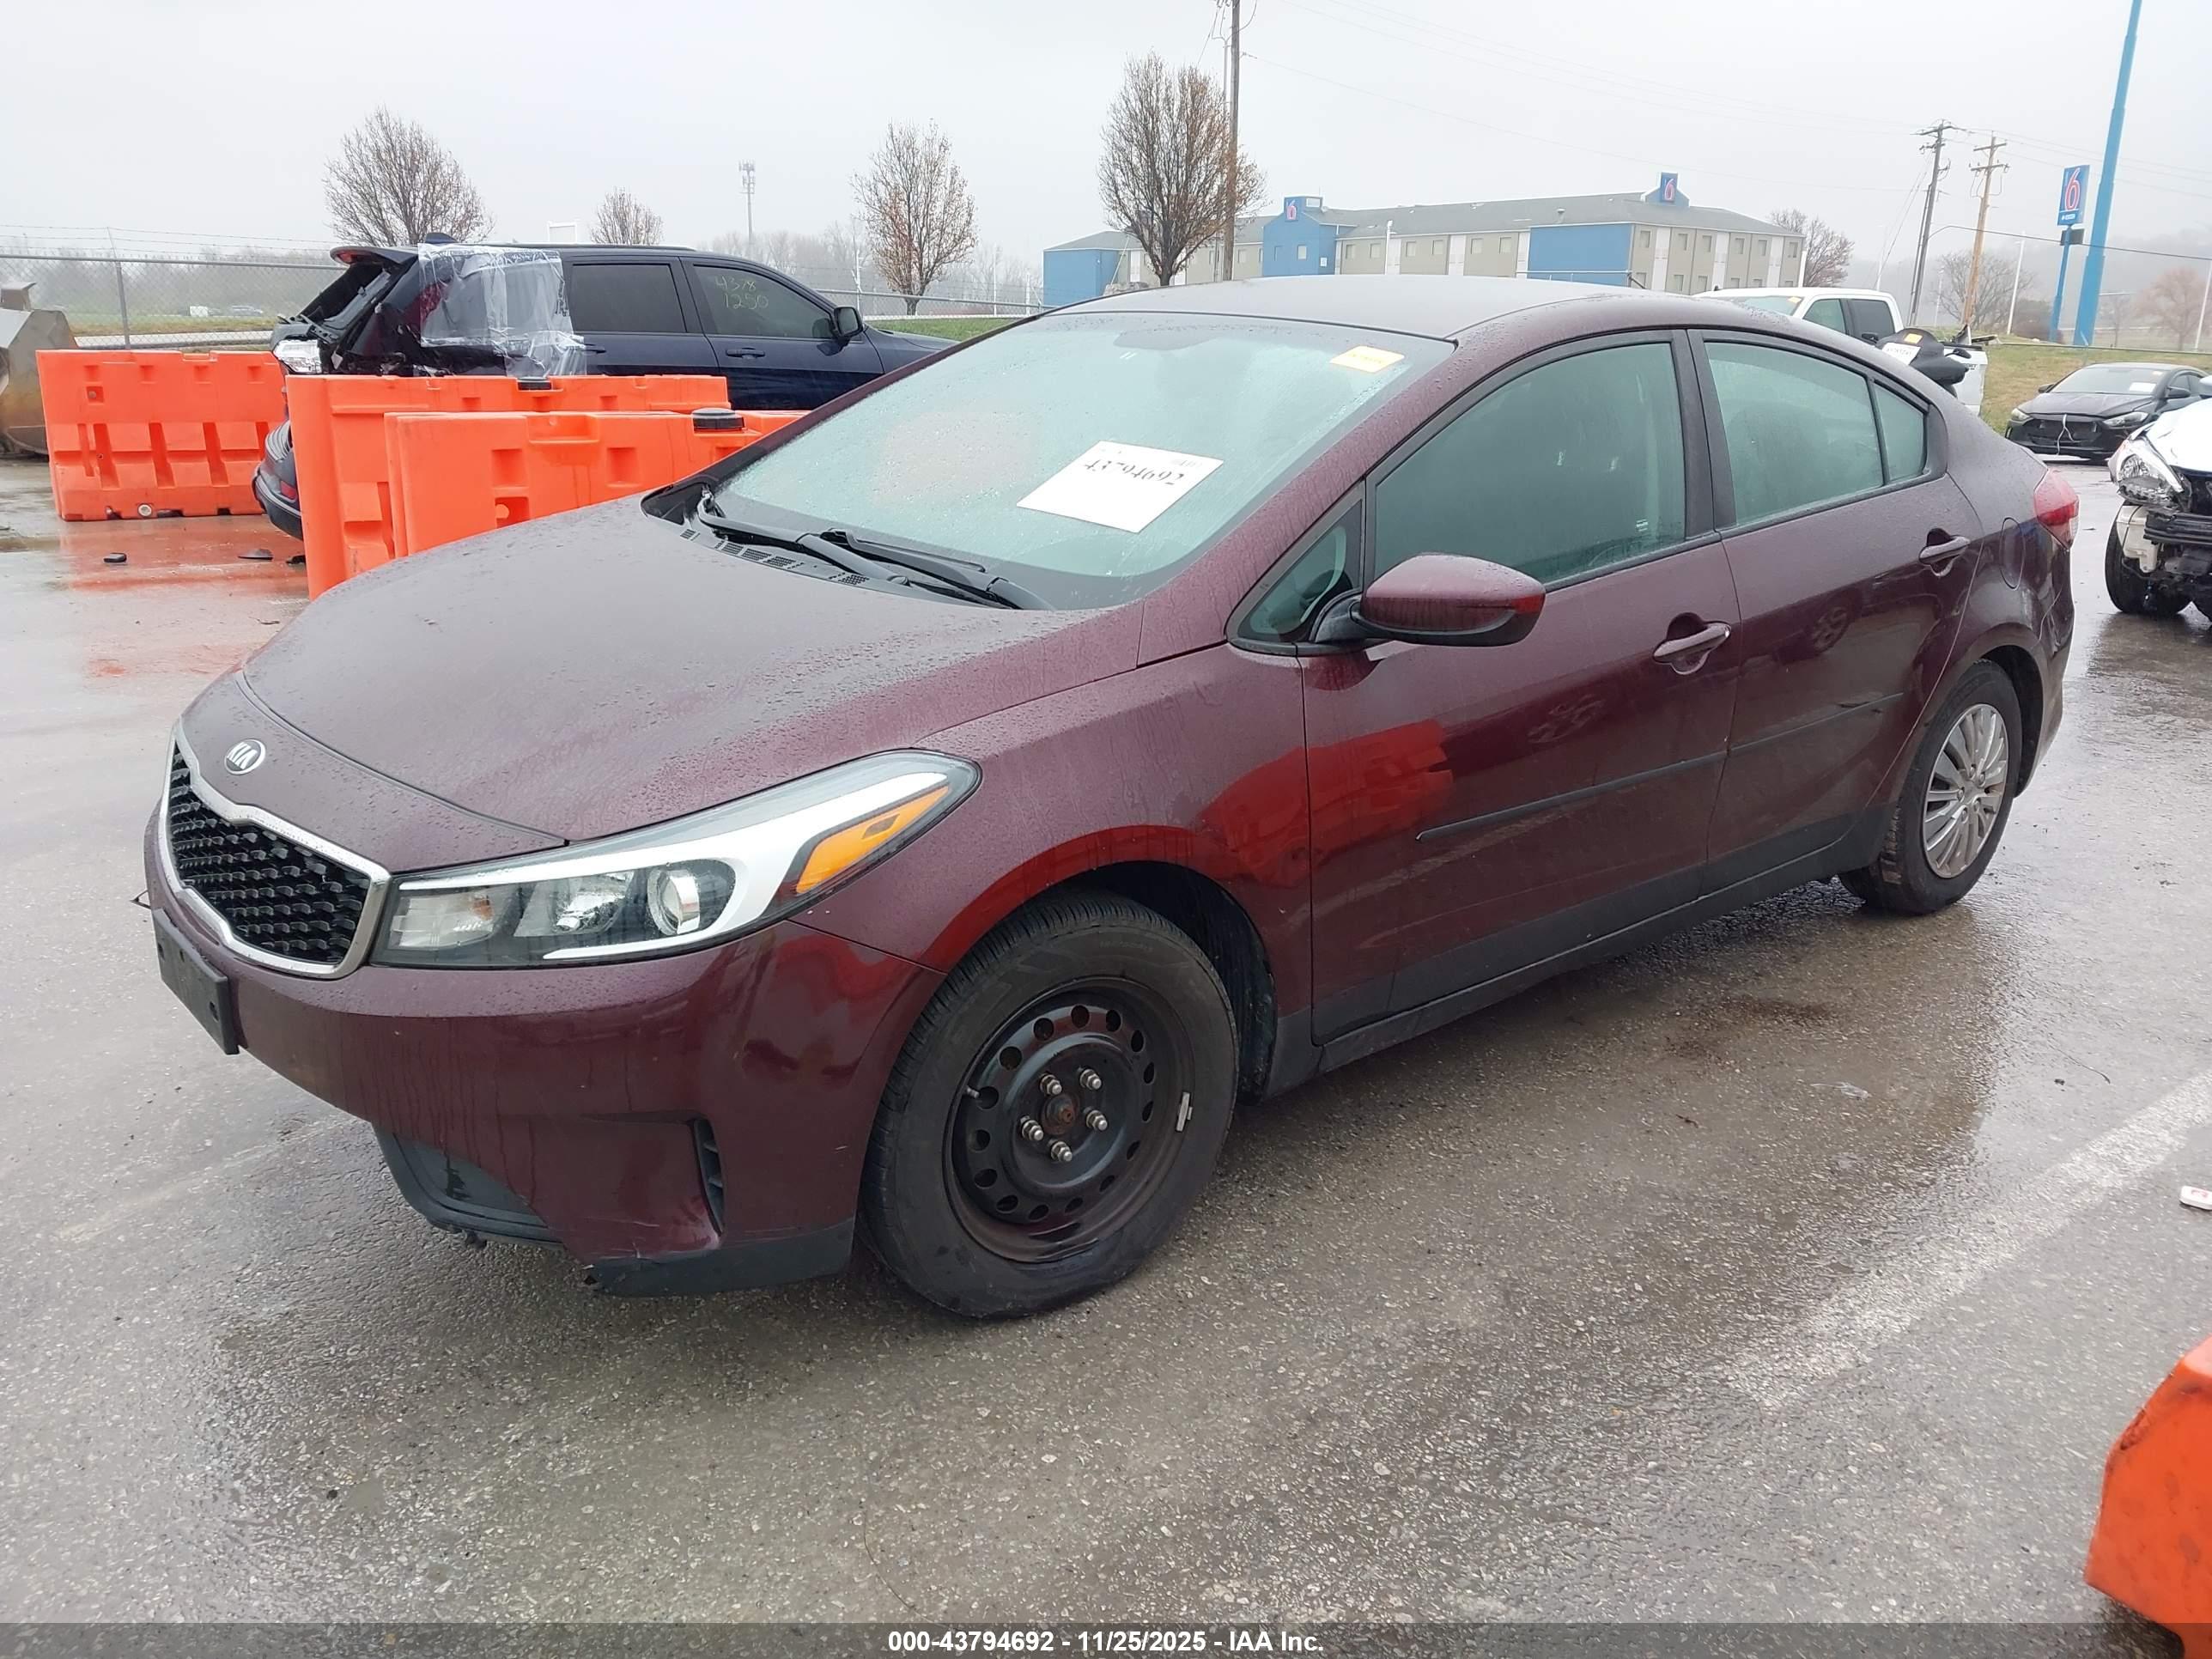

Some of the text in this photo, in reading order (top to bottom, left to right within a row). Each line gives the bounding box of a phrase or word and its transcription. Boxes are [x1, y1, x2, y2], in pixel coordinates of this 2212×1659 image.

[1664, 178, 1675, 201] 6
[2065, 167, 2081, 211] 6
[1286, 198, 1297, 221] 6
[723, 293, 769, 310] 1250
[226, 741, 258, 770] KIA
